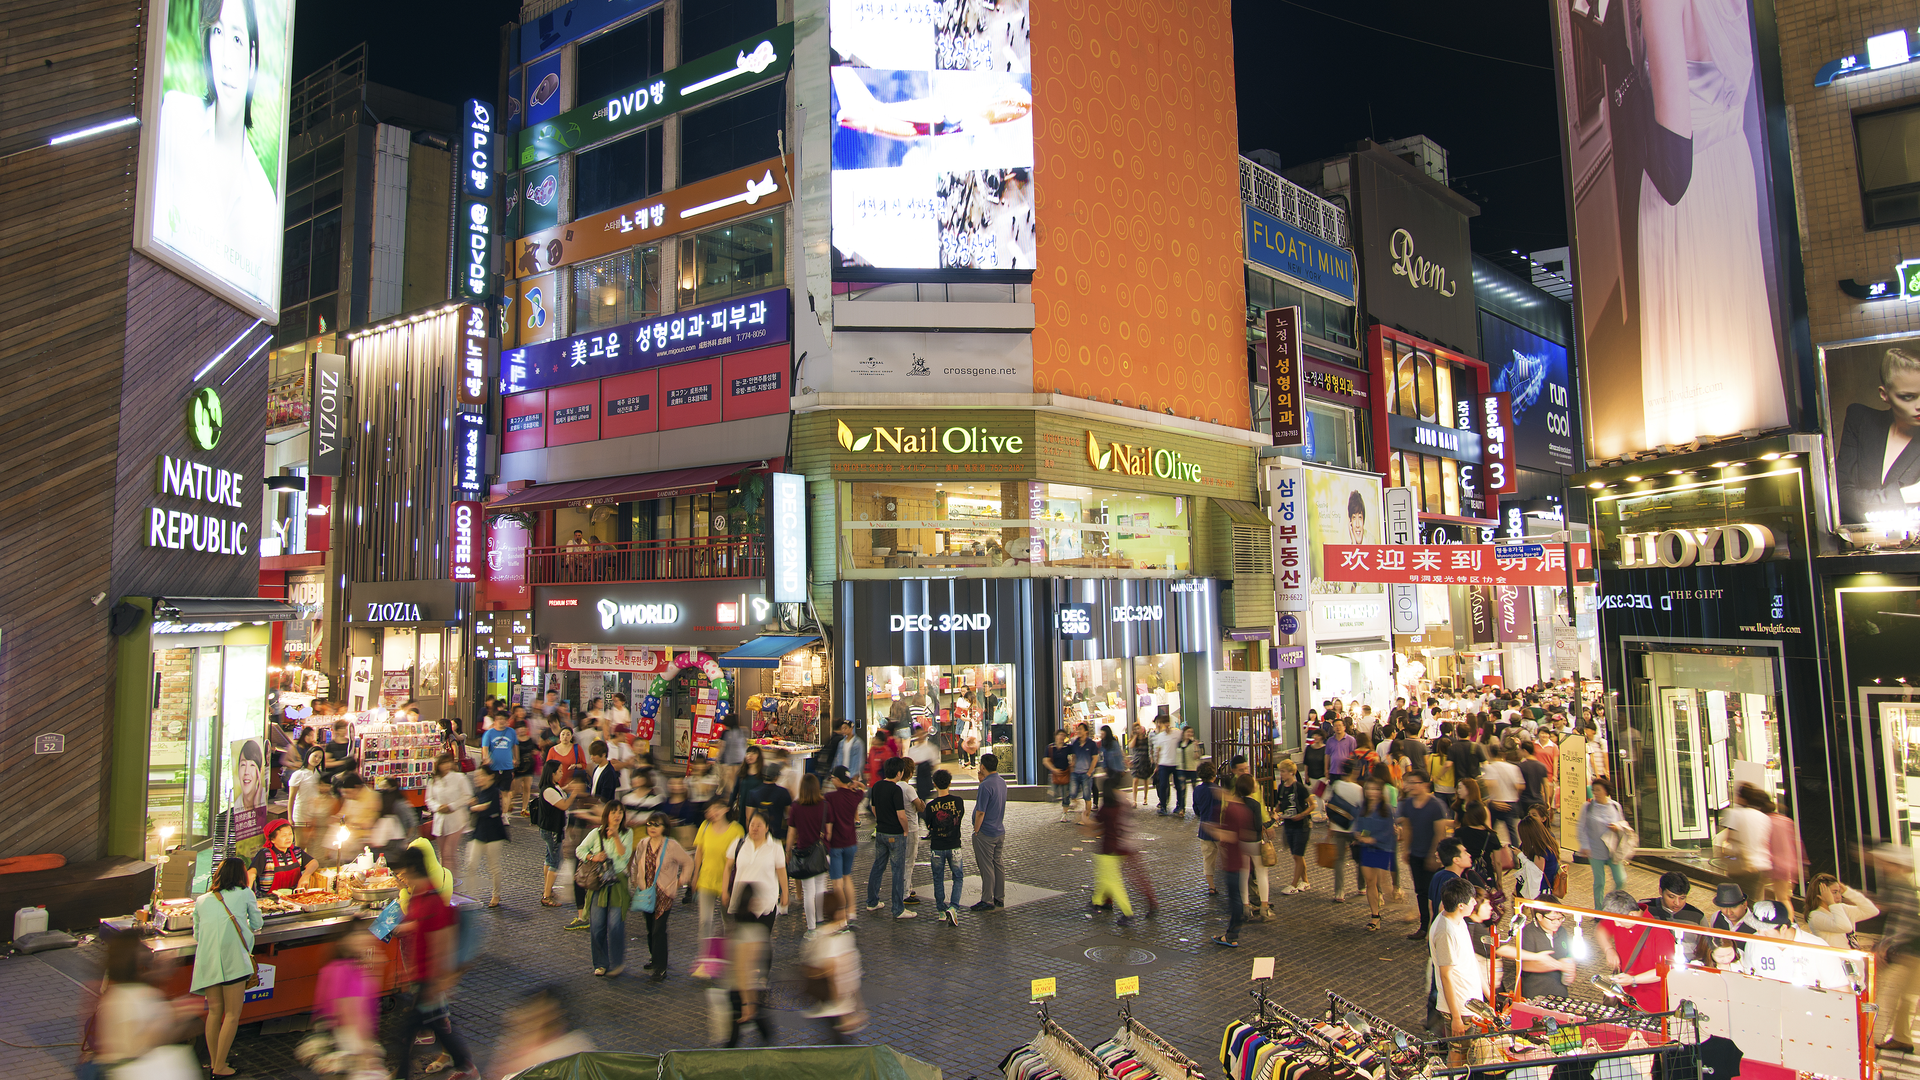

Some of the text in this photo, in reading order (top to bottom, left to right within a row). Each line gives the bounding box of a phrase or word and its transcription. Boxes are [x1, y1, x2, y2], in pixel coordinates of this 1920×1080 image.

[608, 80, 666, 122] DVD방
[620, 203, 666, 234] 노래방
[224, 244, 262, 281] REPUBLIC
[1253, 219, 1349, 282] FLOATI MINI
[1287, 261, 1323, 284] NEW YORK
[1389, 228, 1456, 298] Roem
[1870, 283, 1887, 296] 2F
[635, 299, 768, 353] 성형외과·피부과
[656, 344, 697, 358] www.migoun.com
[736, 329, 767, 343] T.774-8050
[466, 339, 484, 398] 노래방
[943, 366, 1017, 377] crossgene.net
[1275, 318, 1295, 426] 노정식 성형외과
[1324, 373, 1354, 397] 성형외과
[1549, 383, 1569, 408] run
[318, 369, 339, 457] ZIOZIA
[1547, 411, 1570, 438] cool
[873, 426, 1023, 454] Nail Olive
[1414, 426, 1459, 452] JUNO HAIR
[990, 464, 1025, 472] 752-2187
[1110, 442, 1202, 483] Nail Olive
[162, 455, 243, 508] NATURE
[657, 490, 679, 498] SANDWICH
[150, 507, 248, 556] REPUBLIC
[456, 505, 471, 563] COFFEE
[782, 483, 798, 593] DEC.32ND
[1616, 523, 1770, 570] LLOYD
[1409, 574, 1507, 584] 明洞观光特区协会
[1279, 593, 1303, 601] 773-6622
[1668, 589, 1724, 600] THE GIFT
[367, 602, 422, 622] ZIOZIA
[619, 603, 678, 624] WORLD
[890, 612, 991, 633] DEC.32ND
[1061, 608, 1089, 622] DEC.
[1112, 604, 1163, 623] DEC.32ND
[1061, 622, 1090, 634] 32ND
[1739, 623, 1801, 635] www.lloydgift.com
[43, 742, 56, 752] 52
[1562, 754, 1584, 763] TOURIST
[1760, 957, 1776, 972] 99
[258, 991, 270, 999] A42
